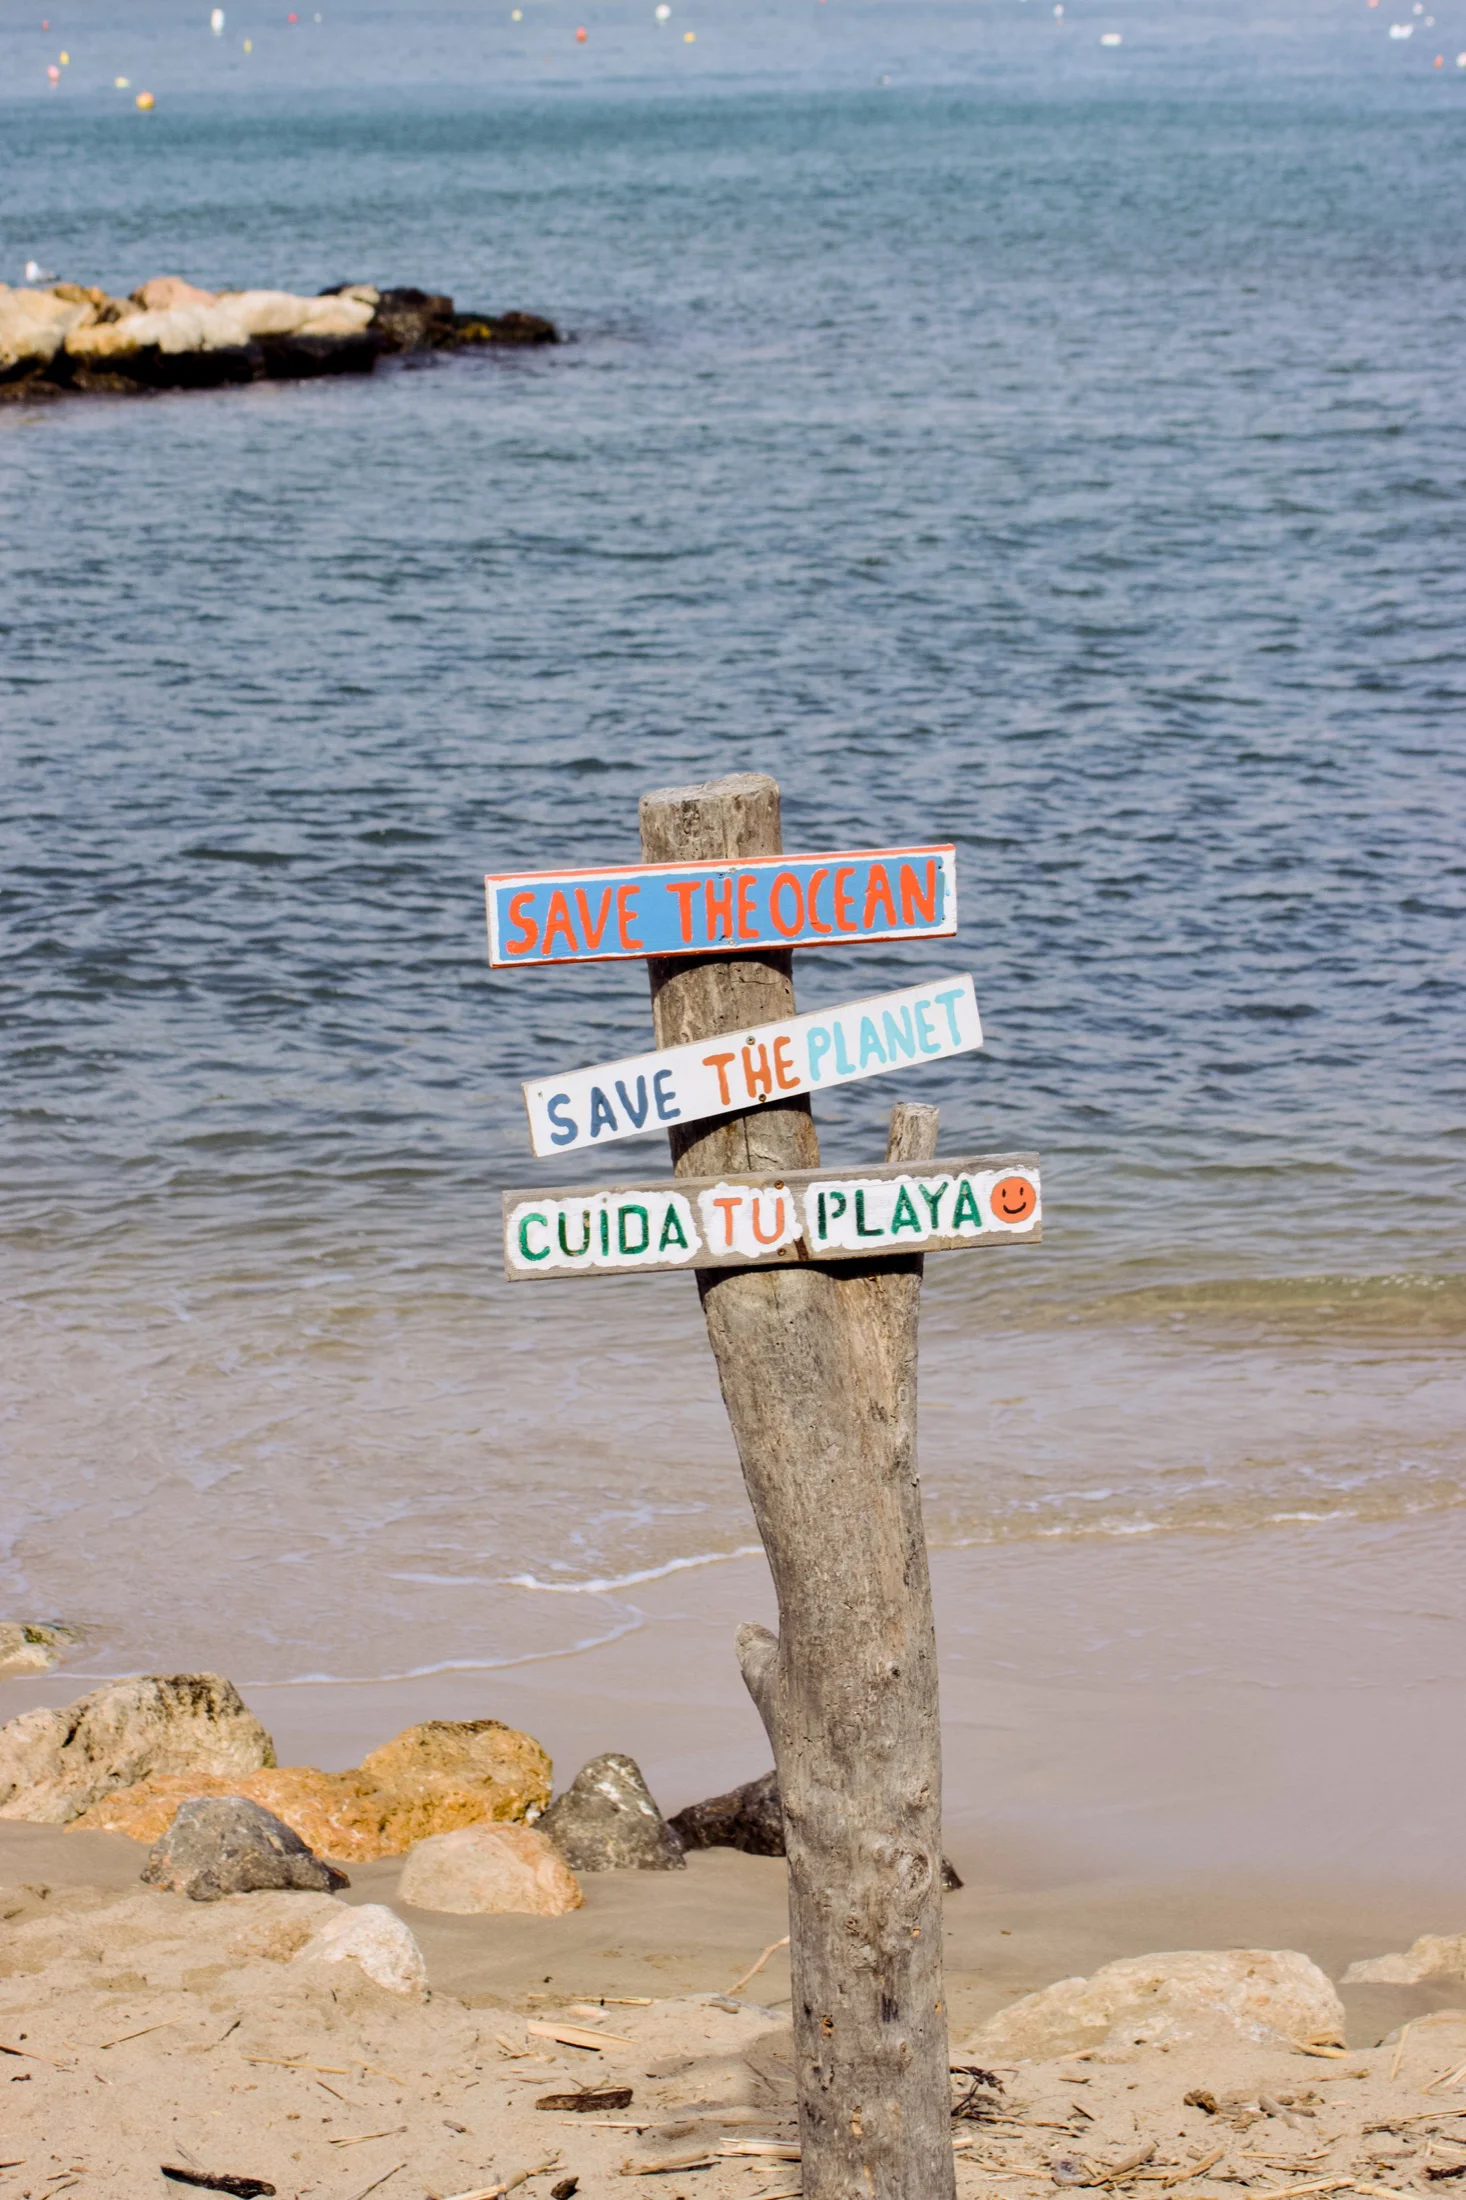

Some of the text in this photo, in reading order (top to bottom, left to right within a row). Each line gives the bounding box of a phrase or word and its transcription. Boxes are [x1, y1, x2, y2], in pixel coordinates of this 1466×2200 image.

[505, 859, 936, 955] SAVE THE OCEAN
[547, 988, 965, 1145] SAVE THE PLANET
[713, 1197, 785, 1246] TU
[817, 1179, 982, 1239] PLAYA
